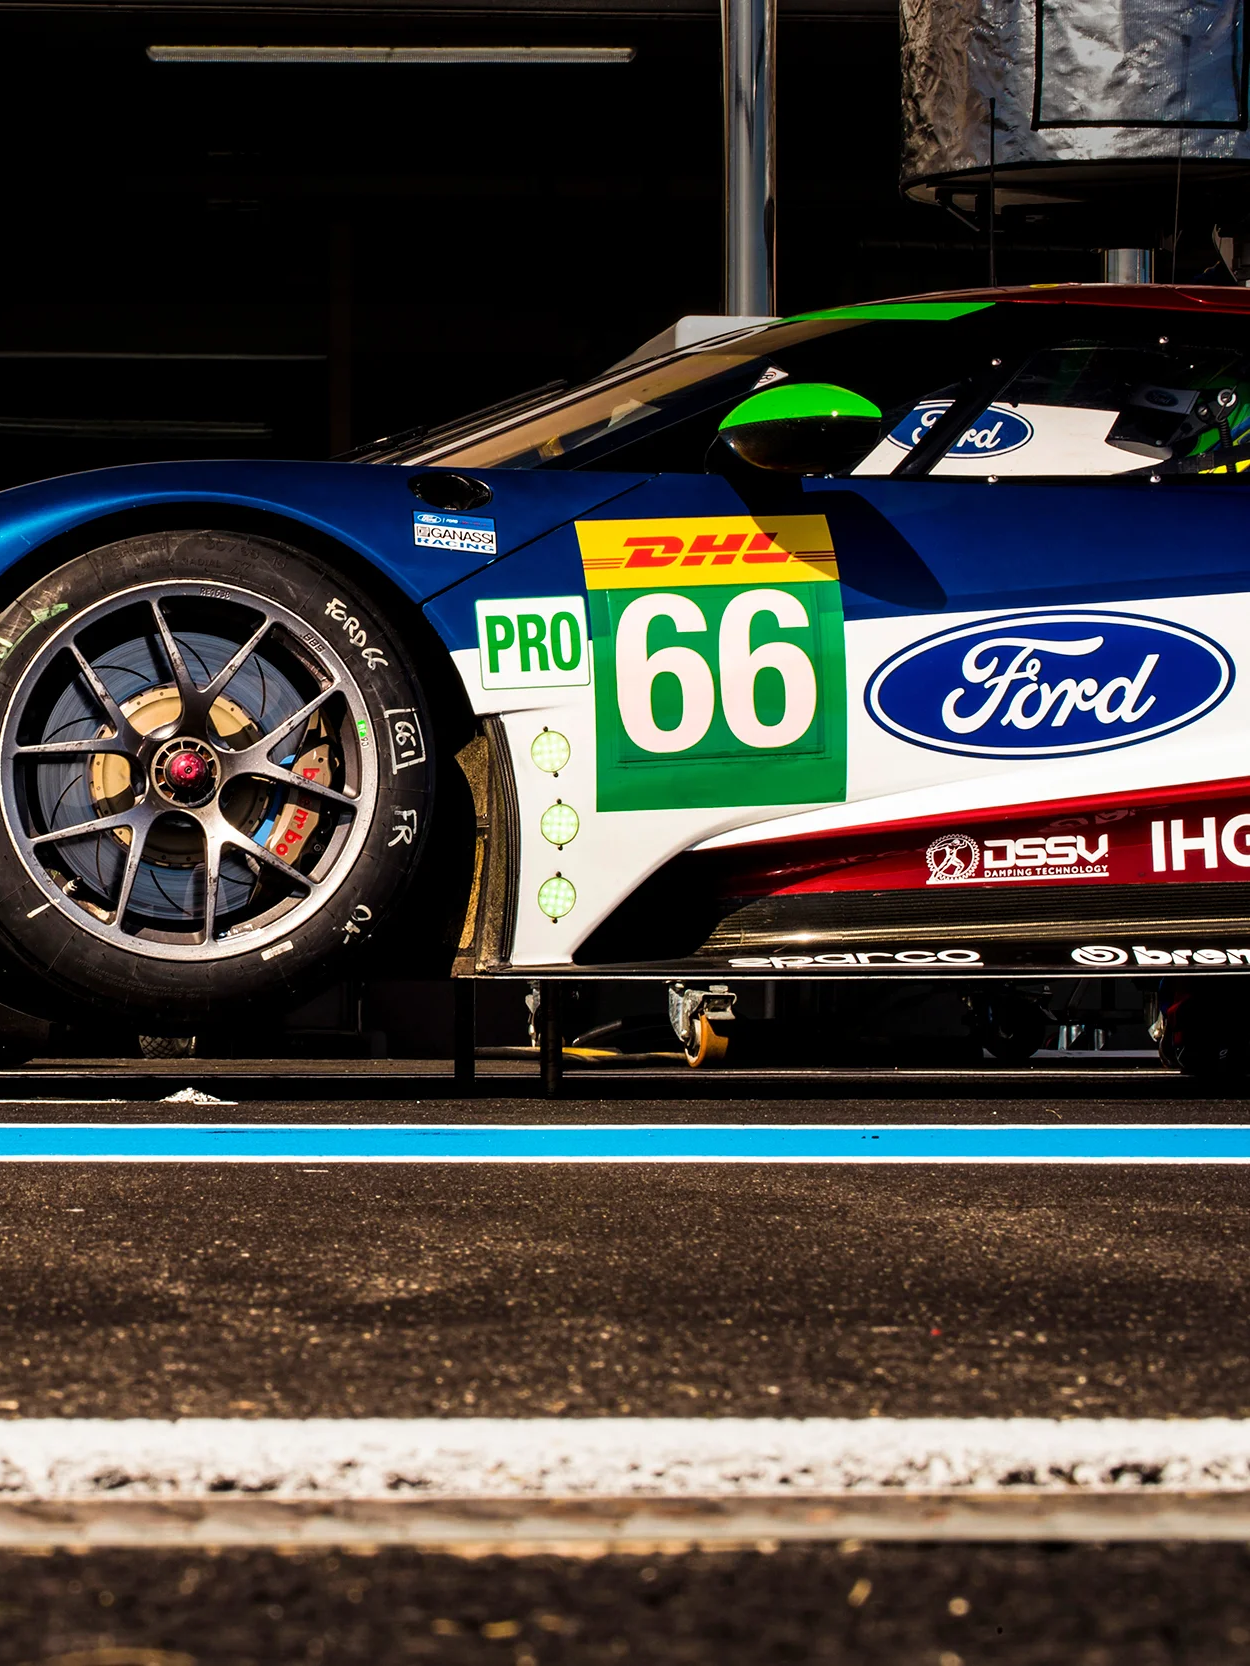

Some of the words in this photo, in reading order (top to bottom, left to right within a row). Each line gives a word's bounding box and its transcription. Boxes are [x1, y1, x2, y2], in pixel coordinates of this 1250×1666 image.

[912, 410, 1003, 449] Frd
[417, 538, 494, 551] RACING
[431, 528, 494, 544] GANASSI
[623, 533, 795, 567] DHL
[324, 598, 367, 647] FORD
[361, 647, 389, 671] 66
[485, 614, 582, 674] PRO
[615, 589, 818, 753] 66
[942, 635, 1156, 729] Ford
[394, 720, 417, 759] 661
[276, 767, 321, 856] bmbo
[388, 809, 418, 848] FR
[984, 834, 1108, 866] DSSV
[984, 867, 1032, 877] DAMPING
[1036, 865, 1108, 876] TECHNOLOGY
[728, 950, 982, 969] sparco
